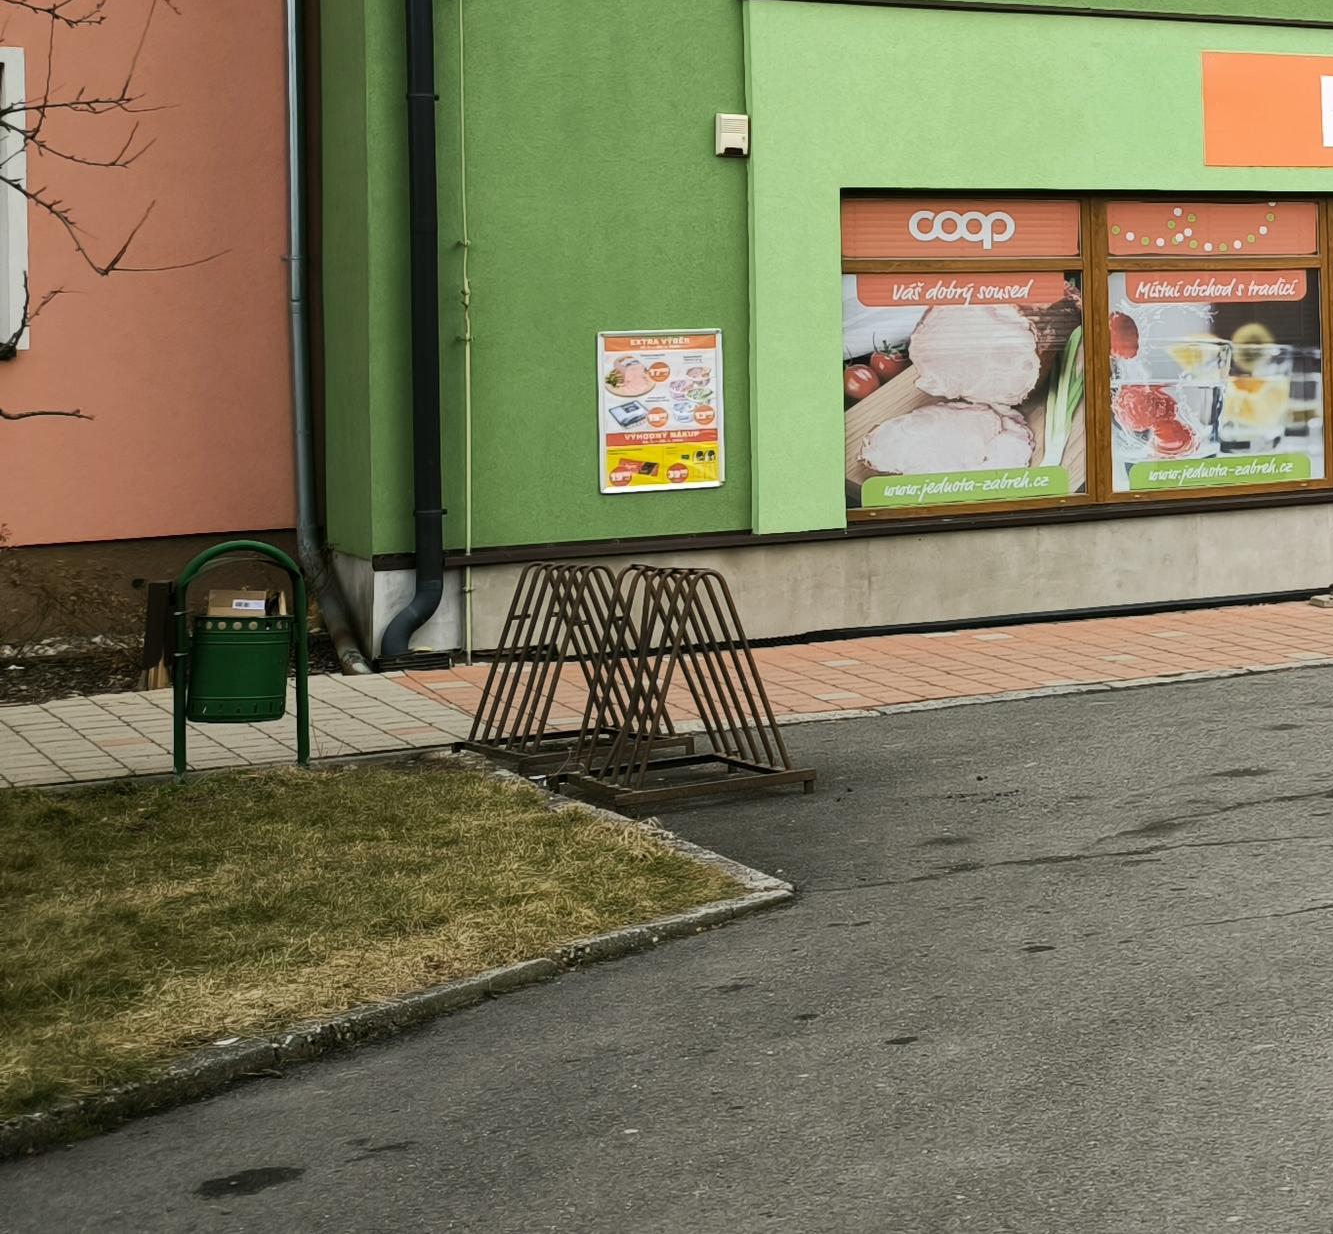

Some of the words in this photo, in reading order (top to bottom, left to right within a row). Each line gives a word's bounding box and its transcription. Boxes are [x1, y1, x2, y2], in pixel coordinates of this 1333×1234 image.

[908, 210, 1016, 250] coop
[892, 281, 924, 301] Váš
[926, 280, 974, 306] dobrý
[976, 279, 1034, 301] soused
[1135, 277, 1183, 299] Místní
[1183, 277, 1236, 298] obchod
[1236, 283, 1245, 297] s
[1248, 277, 1299, 296] tradicí
[630, 338, 659, 346] EXTRA
[1149, 457, 1293, 485] www.jednota-zabreh.cz
[884, 471, 1049, 502] www.jednota-zabreh.cz
